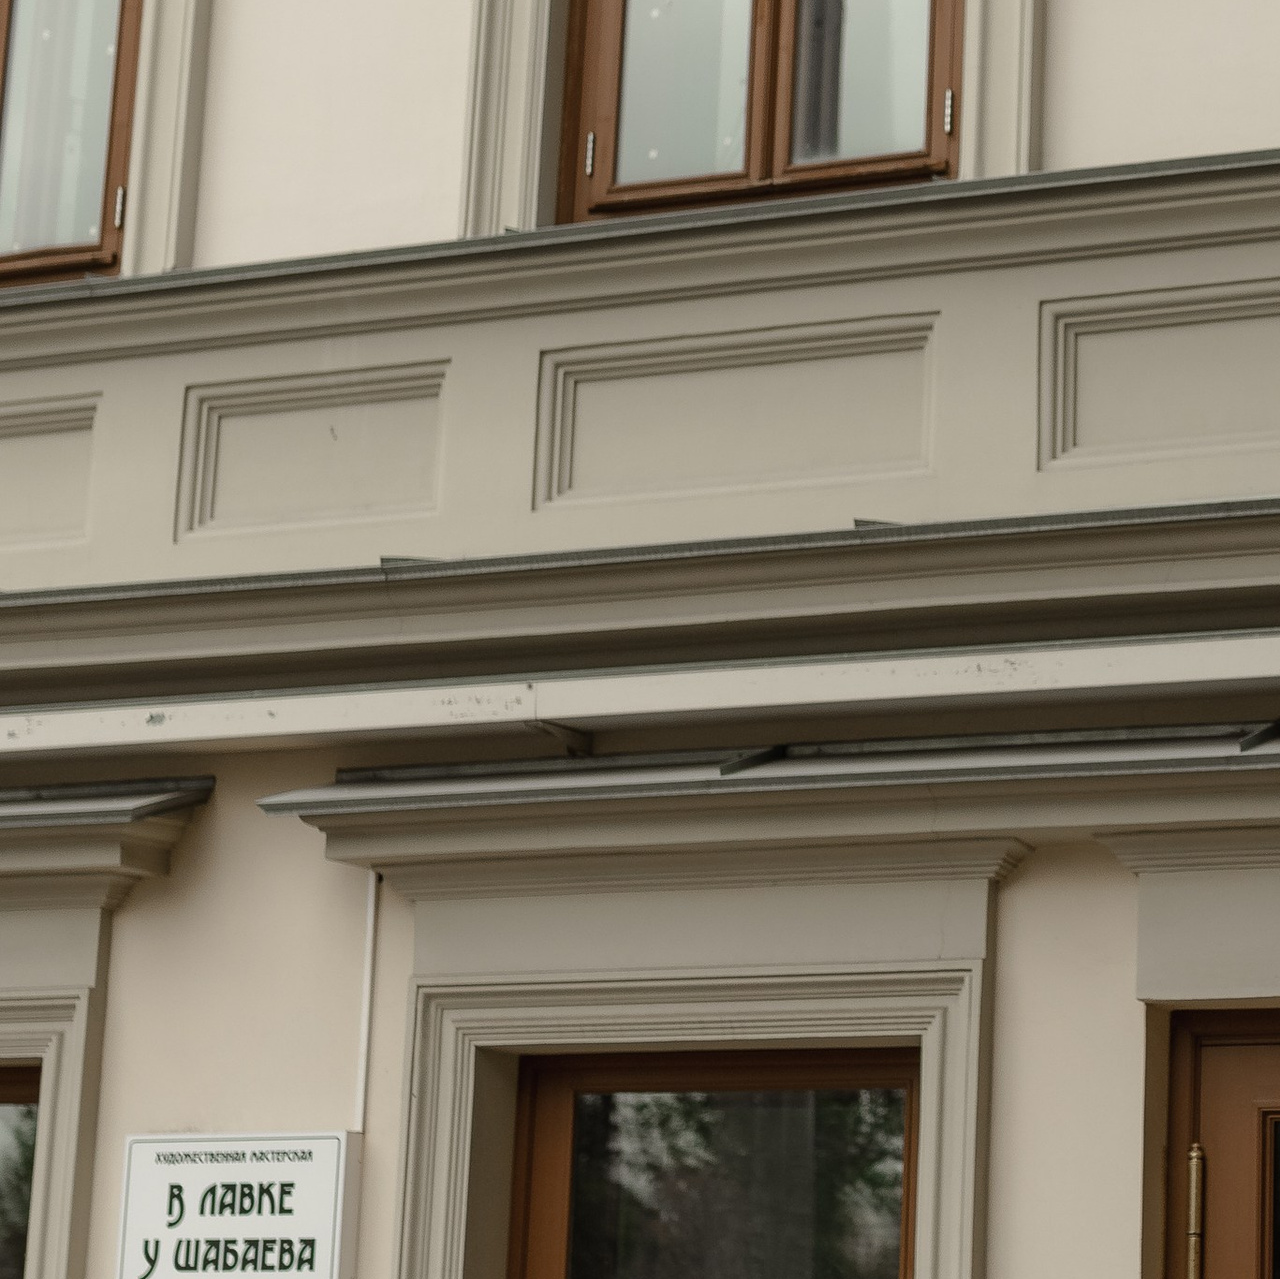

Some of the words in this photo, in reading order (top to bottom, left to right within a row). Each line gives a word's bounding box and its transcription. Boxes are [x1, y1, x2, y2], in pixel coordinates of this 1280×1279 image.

[166, 1183, 185, 1229] В
[199, 1181, 295, 1217] ЛАВКЕ
[174, 1237, 316, 1272] ШАБАЕВА
